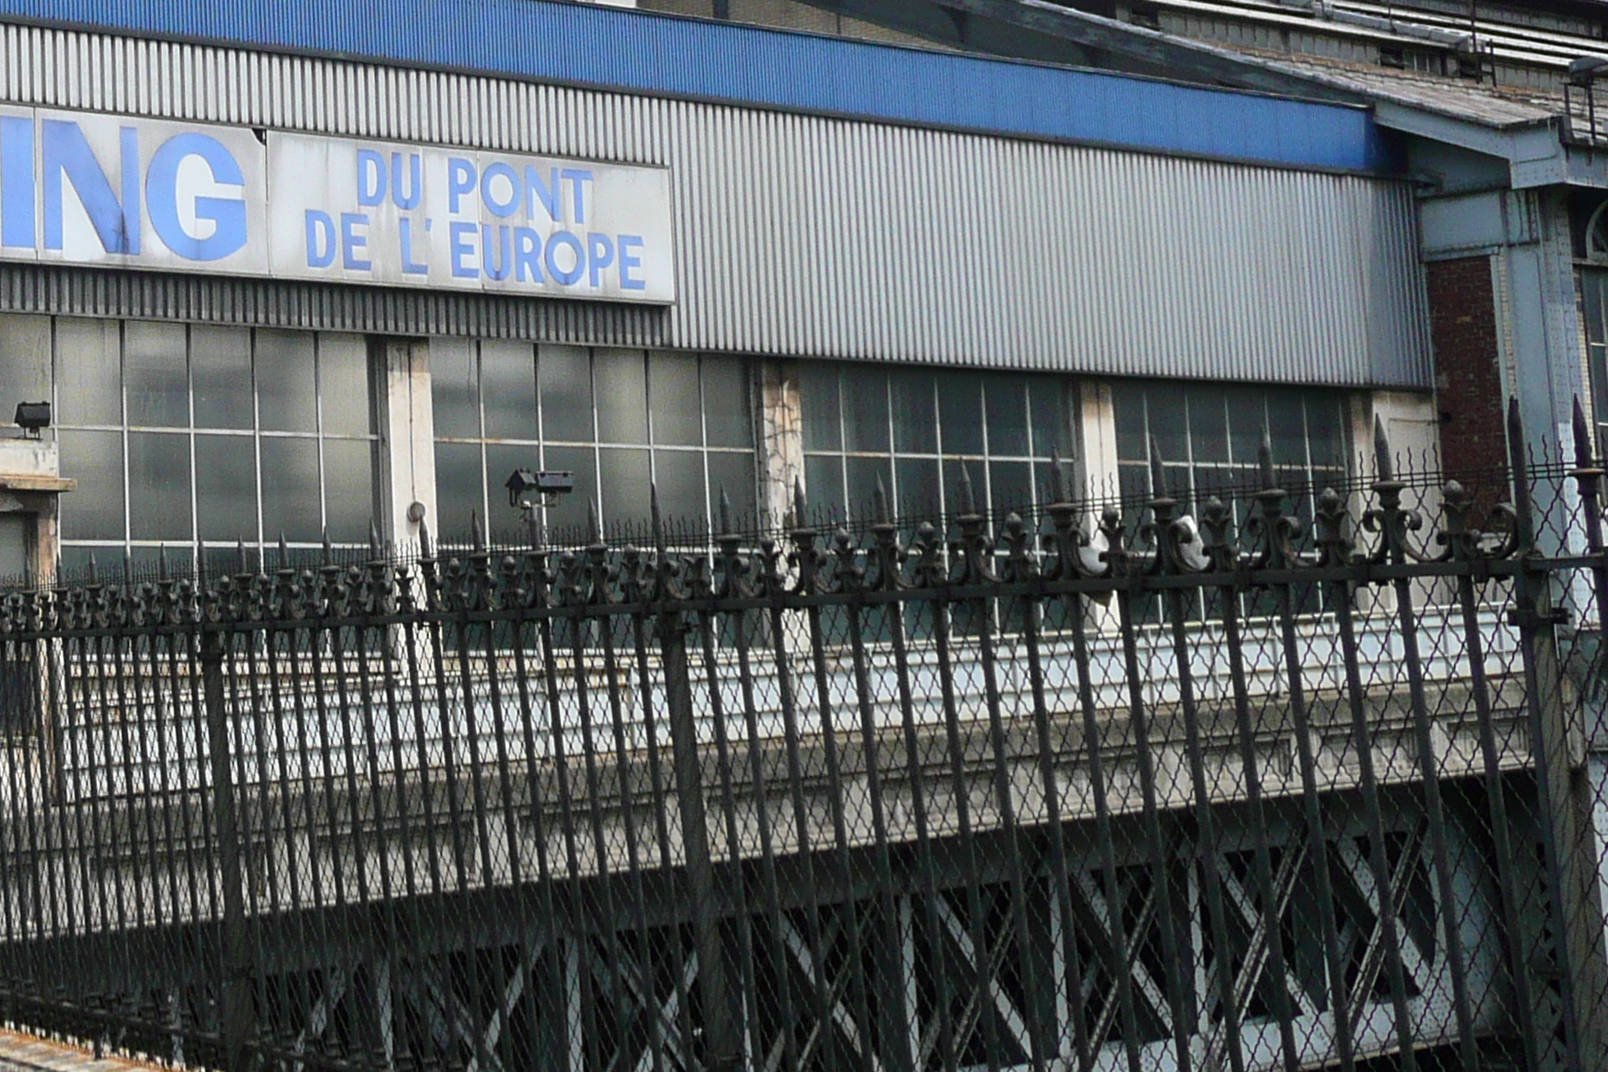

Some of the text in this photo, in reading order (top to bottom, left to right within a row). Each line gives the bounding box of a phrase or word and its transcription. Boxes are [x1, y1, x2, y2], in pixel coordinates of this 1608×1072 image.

[357, 149, 594, 225] DU PONT
[305, 208, 646, 291] DE L'EUROPE
